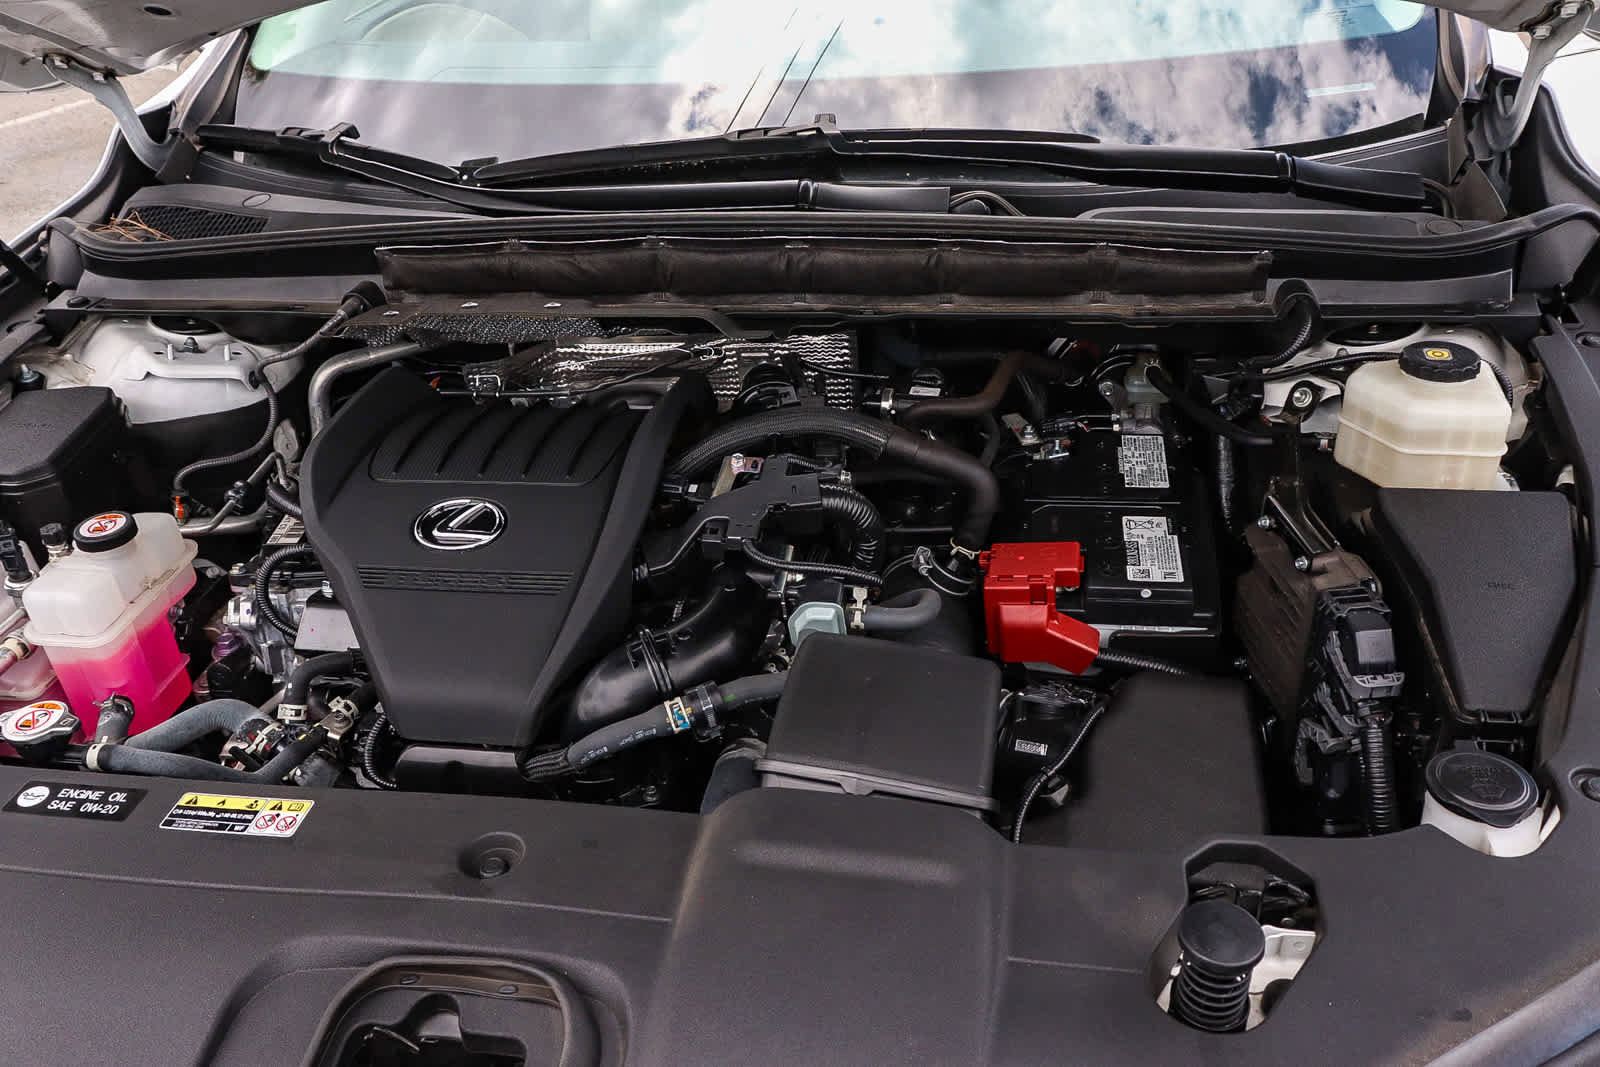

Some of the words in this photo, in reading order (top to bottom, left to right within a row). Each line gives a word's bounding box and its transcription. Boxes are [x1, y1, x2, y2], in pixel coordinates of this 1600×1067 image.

[57, 788, 105, 801] ENGINE
[108, 792, 128, 803] OIL
[47, 800, 76, 811] SAE
[80, 802, 120, 815] 0W-20
